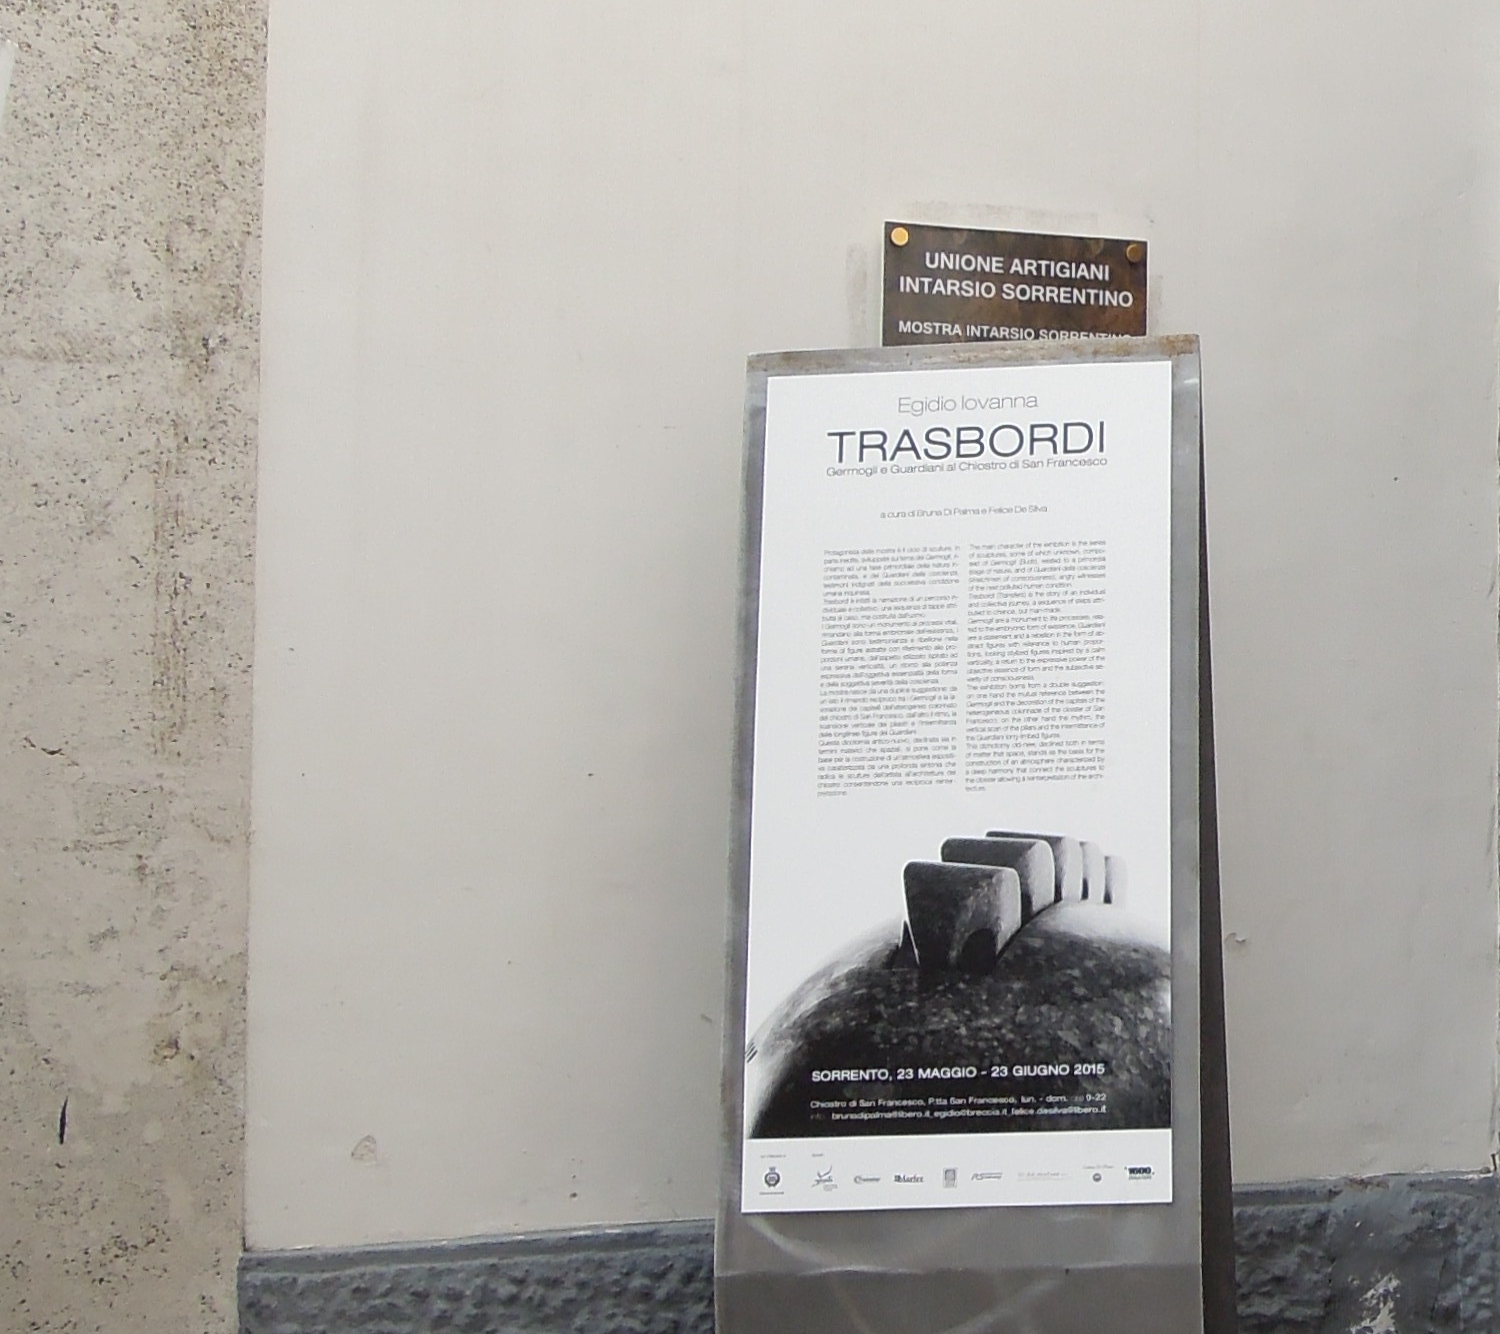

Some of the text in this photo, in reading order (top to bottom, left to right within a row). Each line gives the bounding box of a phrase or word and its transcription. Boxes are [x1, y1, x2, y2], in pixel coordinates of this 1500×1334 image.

[925, 252, 1109, 281] UNIONE ARTIGIANI
[900, 276, 1133, 307] INTARSIO SORRENTINO
[899, 321, 962, 336] MOSTRA
[967, 325, 1034, 340] INTARSIO
[898, 396, 956, 416] Egidio
[827, 421, 1104, 463] TRASBORDI
[826, 465, 877, 477] Germogli
[890, 463, 944, 474] Guardiani
[947, 462, 956, 471] al
[959, 460, 1006, 471] Chiostro
[1009, 459, 1019, 469] di
[1022, 458, 1043, 468] San
[1047, 456, 1107, 467] Francesco
[812, 1069, 892, 1082] SORRENTO,
[897, 1068, 913, 1079] 23
[918, 1066, 977, 1079] MAGGIO
[991, 1066, 1008, 1077] 23
[1013, 1064, 1069, 1076] GIUGNO
[1074, 1063, 1105, 1075] 2015
